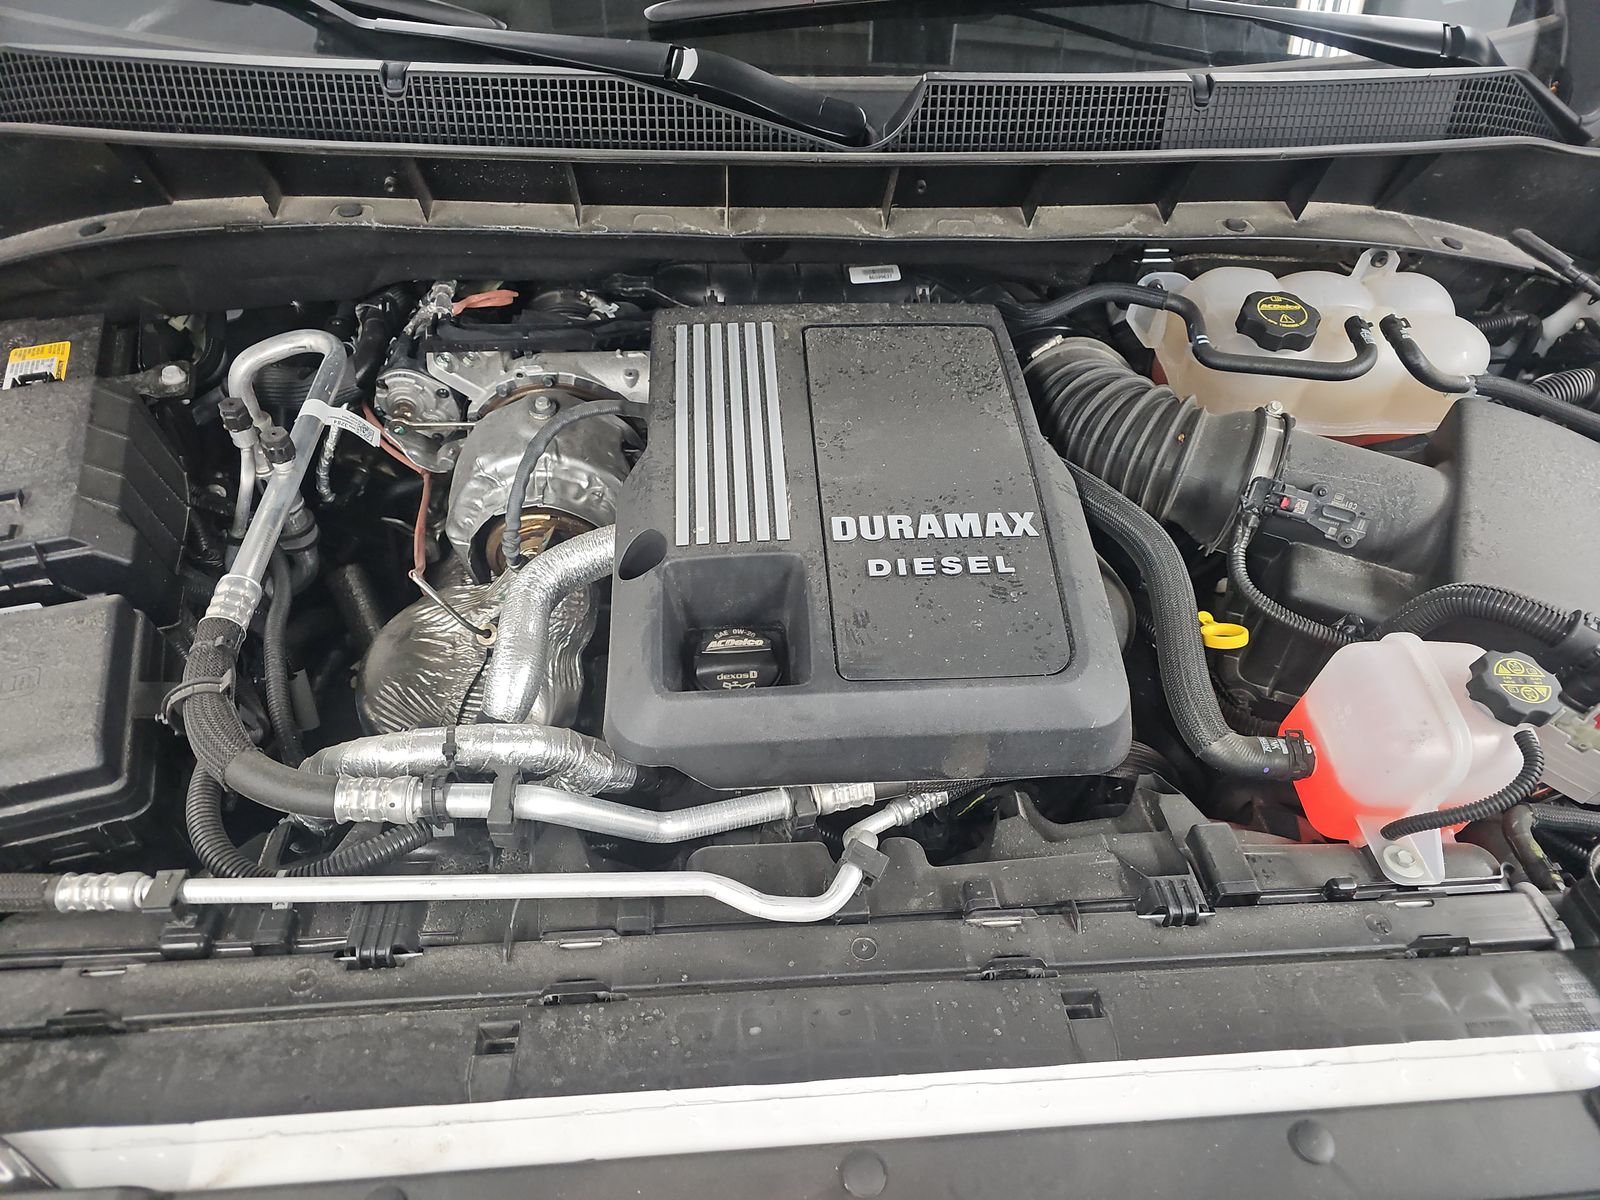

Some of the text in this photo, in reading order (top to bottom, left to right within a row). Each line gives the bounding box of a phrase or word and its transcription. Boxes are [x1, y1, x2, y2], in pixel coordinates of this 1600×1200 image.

[831, 511, 1040, 542] DURAMAX
[867, 555, 1016, 577] DIESEL
[714, 628, 756, 640] SAE 0W-20
[706, 638, 764, 652] ACDelco
